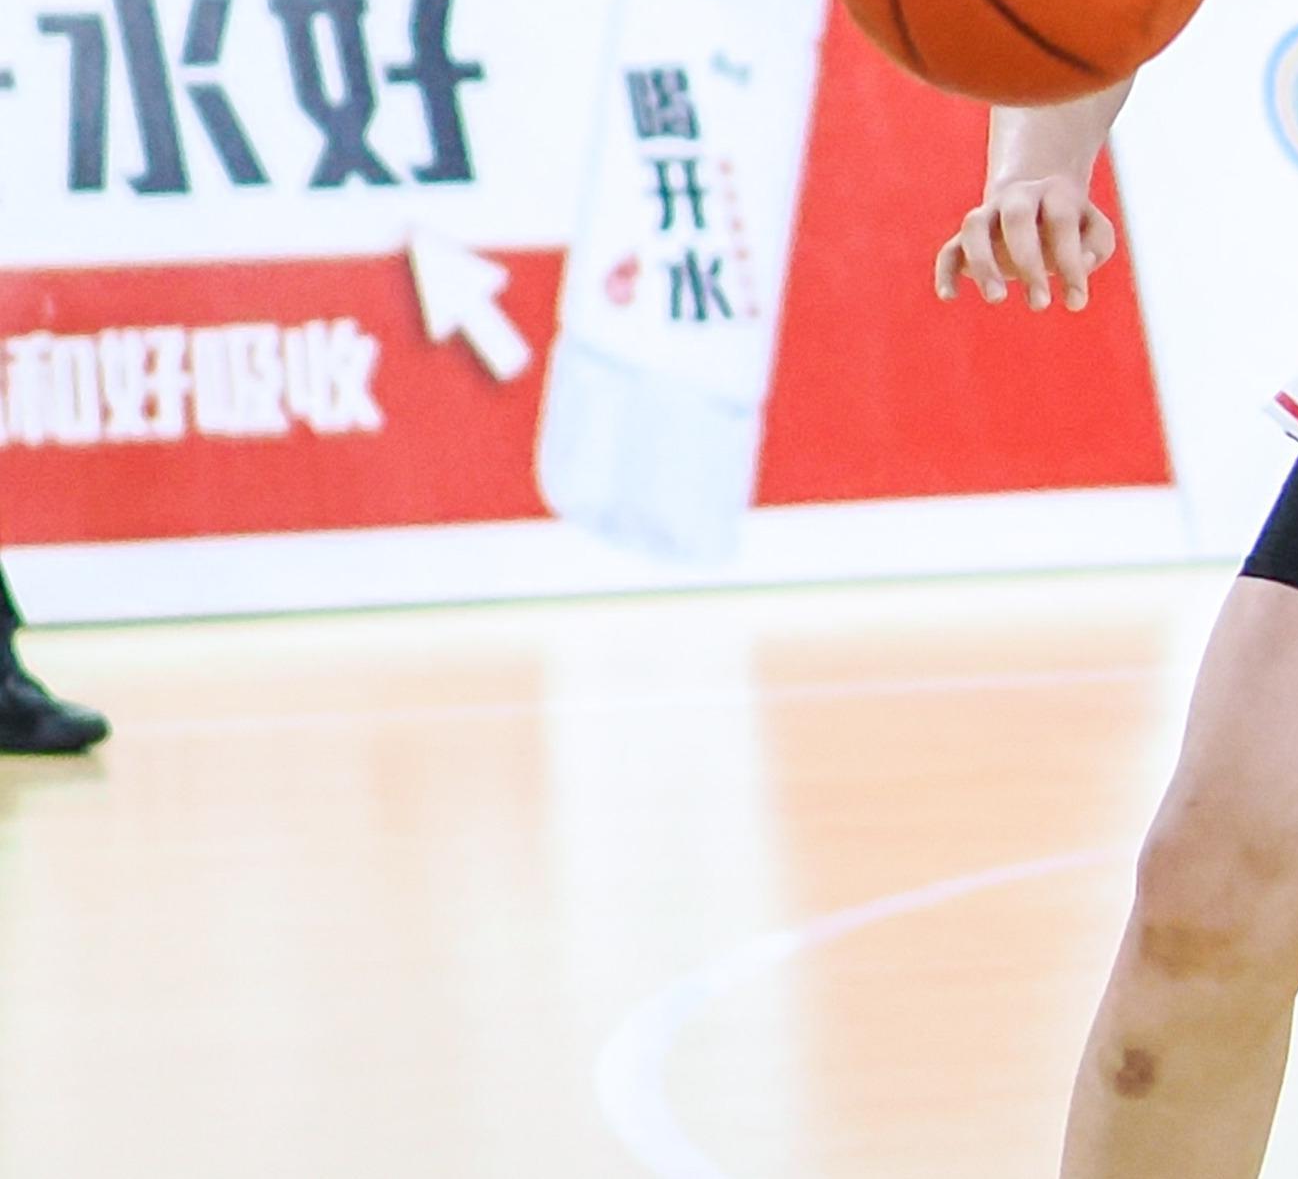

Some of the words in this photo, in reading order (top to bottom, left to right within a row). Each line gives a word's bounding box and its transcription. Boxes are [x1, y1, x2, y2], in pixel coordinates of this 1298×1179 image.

[624, 66, 734, 323] 喝开水
[0, 318, 383, 449] 和好吸收
